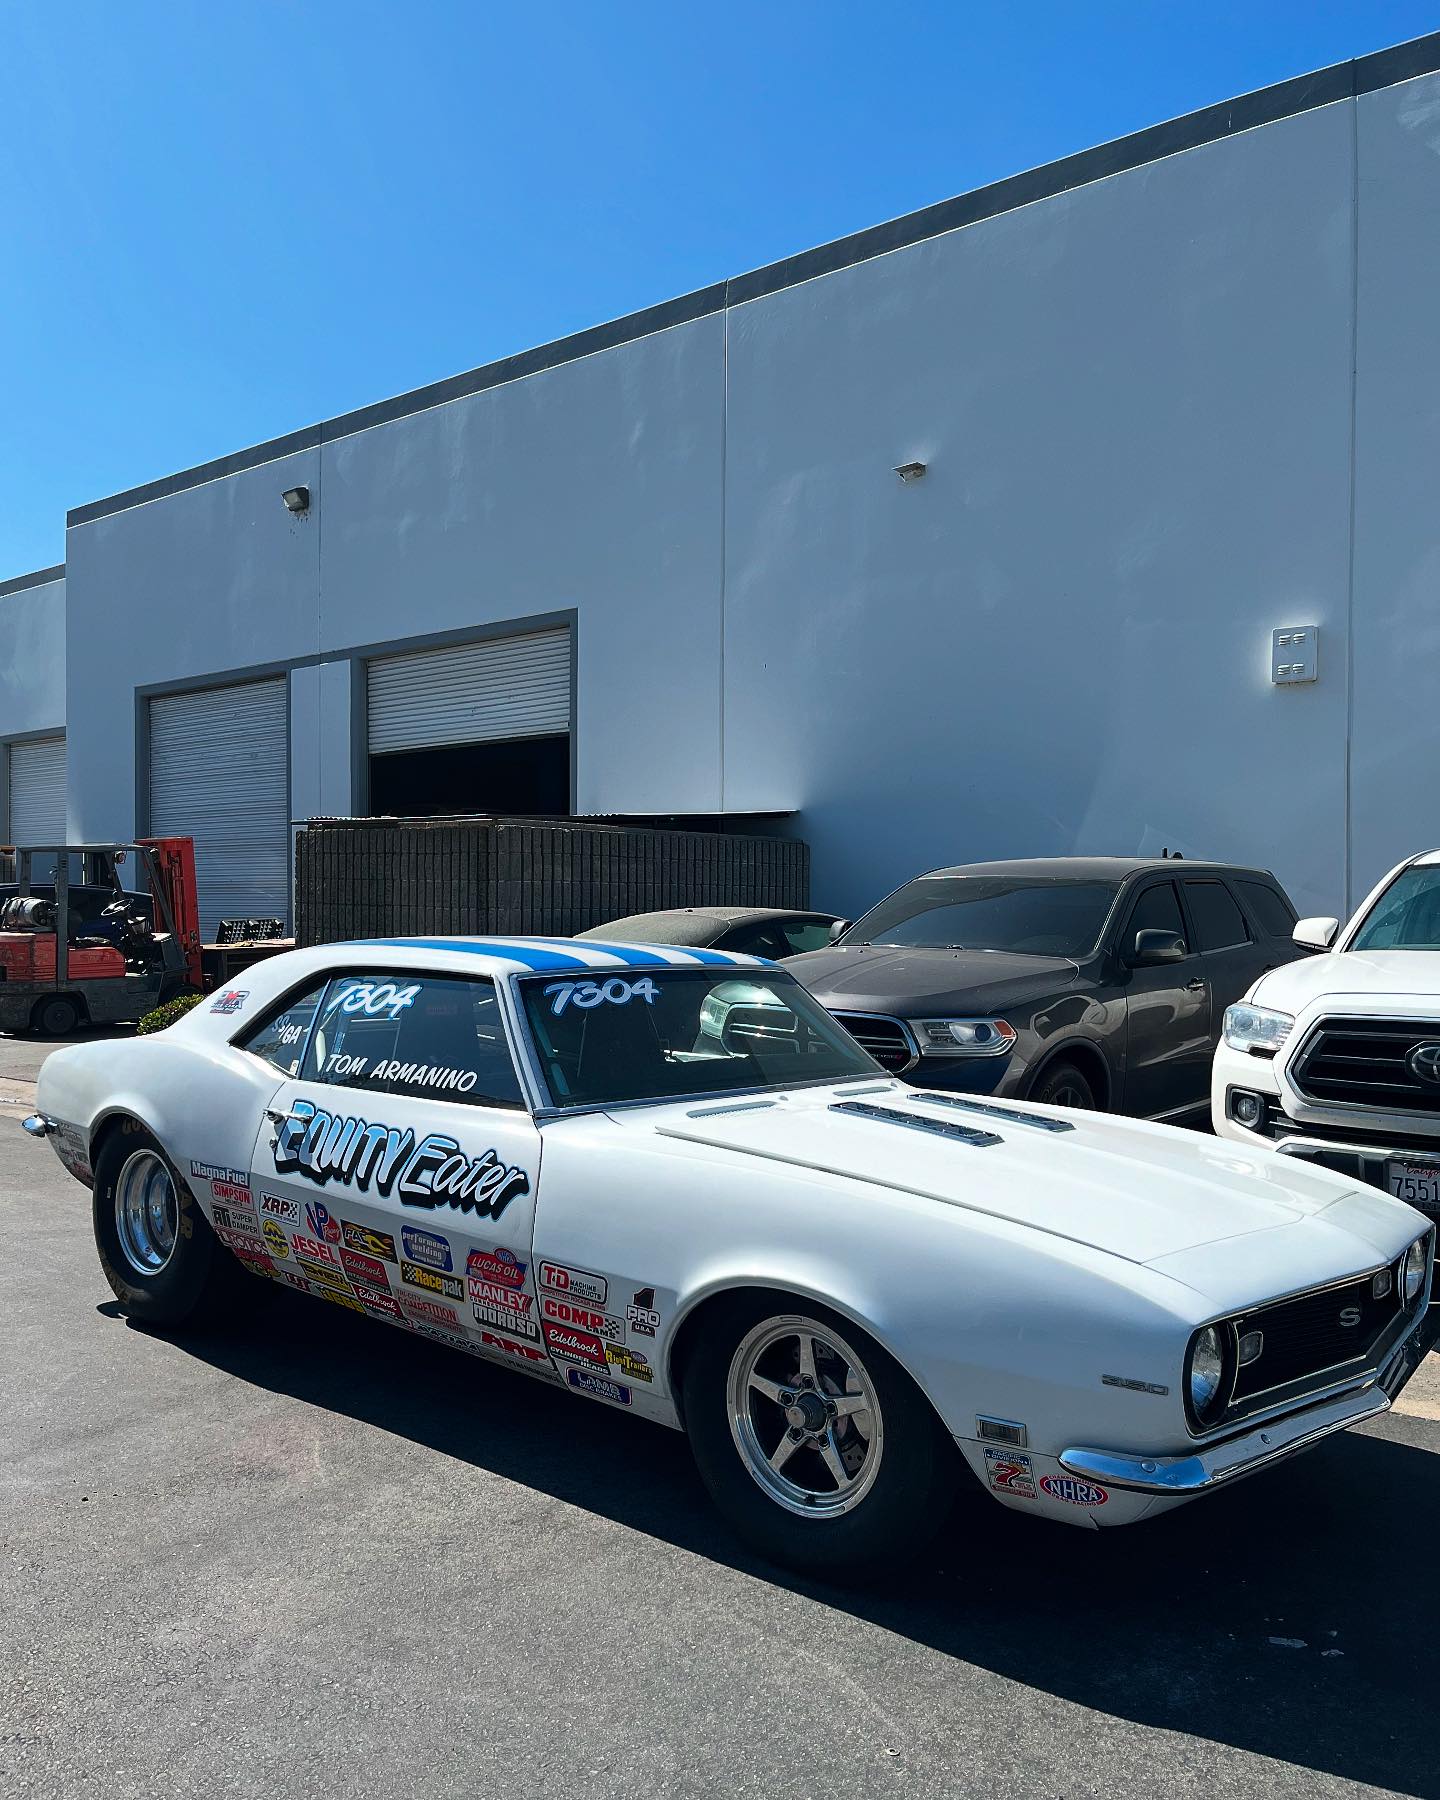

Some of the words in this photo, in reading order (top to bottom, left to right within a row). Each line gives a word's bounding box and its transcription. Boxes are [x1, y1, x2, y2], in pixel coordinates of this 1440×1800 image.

[322, 979, 423, 1019] 7304
[543, 978, 661, 1016] 7304
[326, 1054, 368, 1076] TOM
[370, 1060, 478, 1092] ARMANINO
[276, 1100, 415, 1196] EQUITY
[400, 1134, 528, 1219] Eater
[191, 1161, 249, 1185] MagnaFuel
[213, 1184, 251, 1203] SIMPSON
[261, 1195, 290, 1216] XRP
[231, 1211, 253, 1224] SUPER
[232, 1221, 258, 1234] DAMPER
[290, 1233, 342, 1266] JESEL
[412, 1242, 442, 1260] welding
[345, 1255, 384, 1278] Edelbrock
[472, 1256, 503, 1274] LUCAS
[503, 1266, 519, 1280] OIL
[415, 1268, 463, 1298] Racepak
[570, 1279, 597, 1292] MACHINE
[570, 1286, 602, 1300] PRODUCTS
[359, 1289, 397, 1311] Edelbrock
[469, 1279, 526, 1312] MANLEY
[473, 1303, 537, 1338] MOROSO
[544, 1299, 604, 1329] COMP
[627, 1305, 660, 1327] PRO
[549, 1329, 600, 1356] Edelbrock
[586, 1325, 616, 1339] CAMS
[550, 1346, 589, 1363] CYLINDER
[580, 1360, 609, 1375] HEADS
[994, 1462, 1022, 1488] 7
[1050, 1480, 1099, 1502] NHRA
